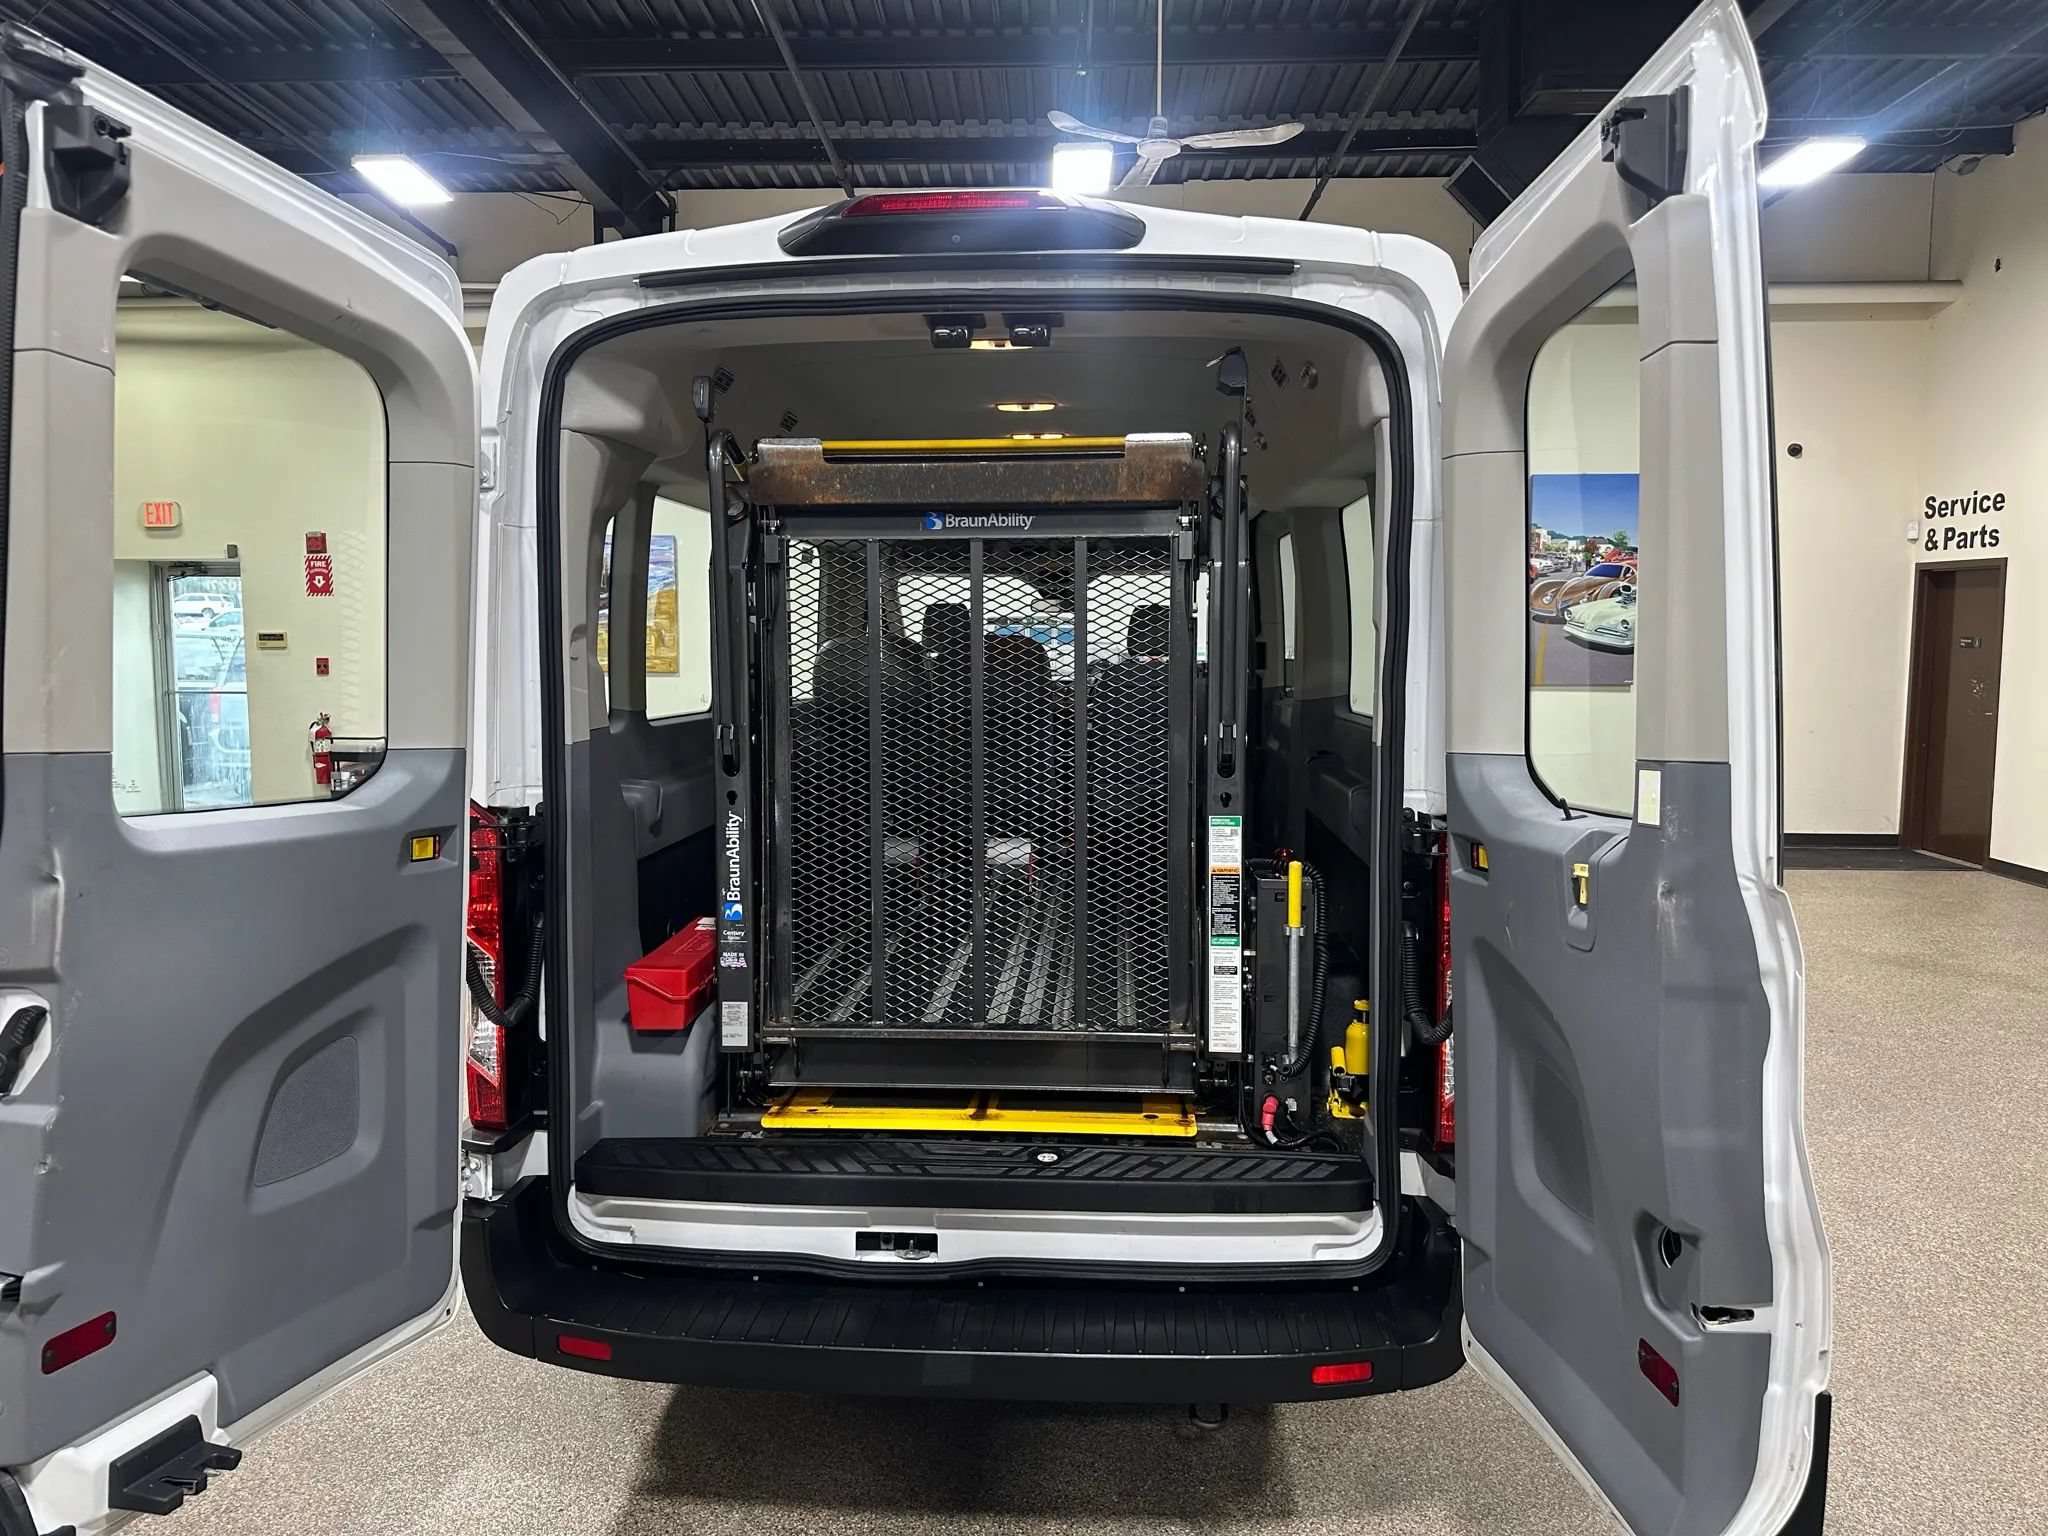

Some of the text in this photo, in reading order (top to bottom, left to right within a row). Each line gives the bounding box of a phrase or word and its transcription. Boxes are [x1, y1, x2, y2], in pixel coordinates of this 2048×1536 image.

[145, 502, 174, 525] EXIT
[1924, 490, 2006, 519] Service
[945, 513, 1033, 531] BraunAbility
[1924, 524, 2000, 552] & Parts
[310, 560, 327, 568] FIRE
[725, 810, 743, 901] BraunAbility
[722, 929, 745, 937] Century
